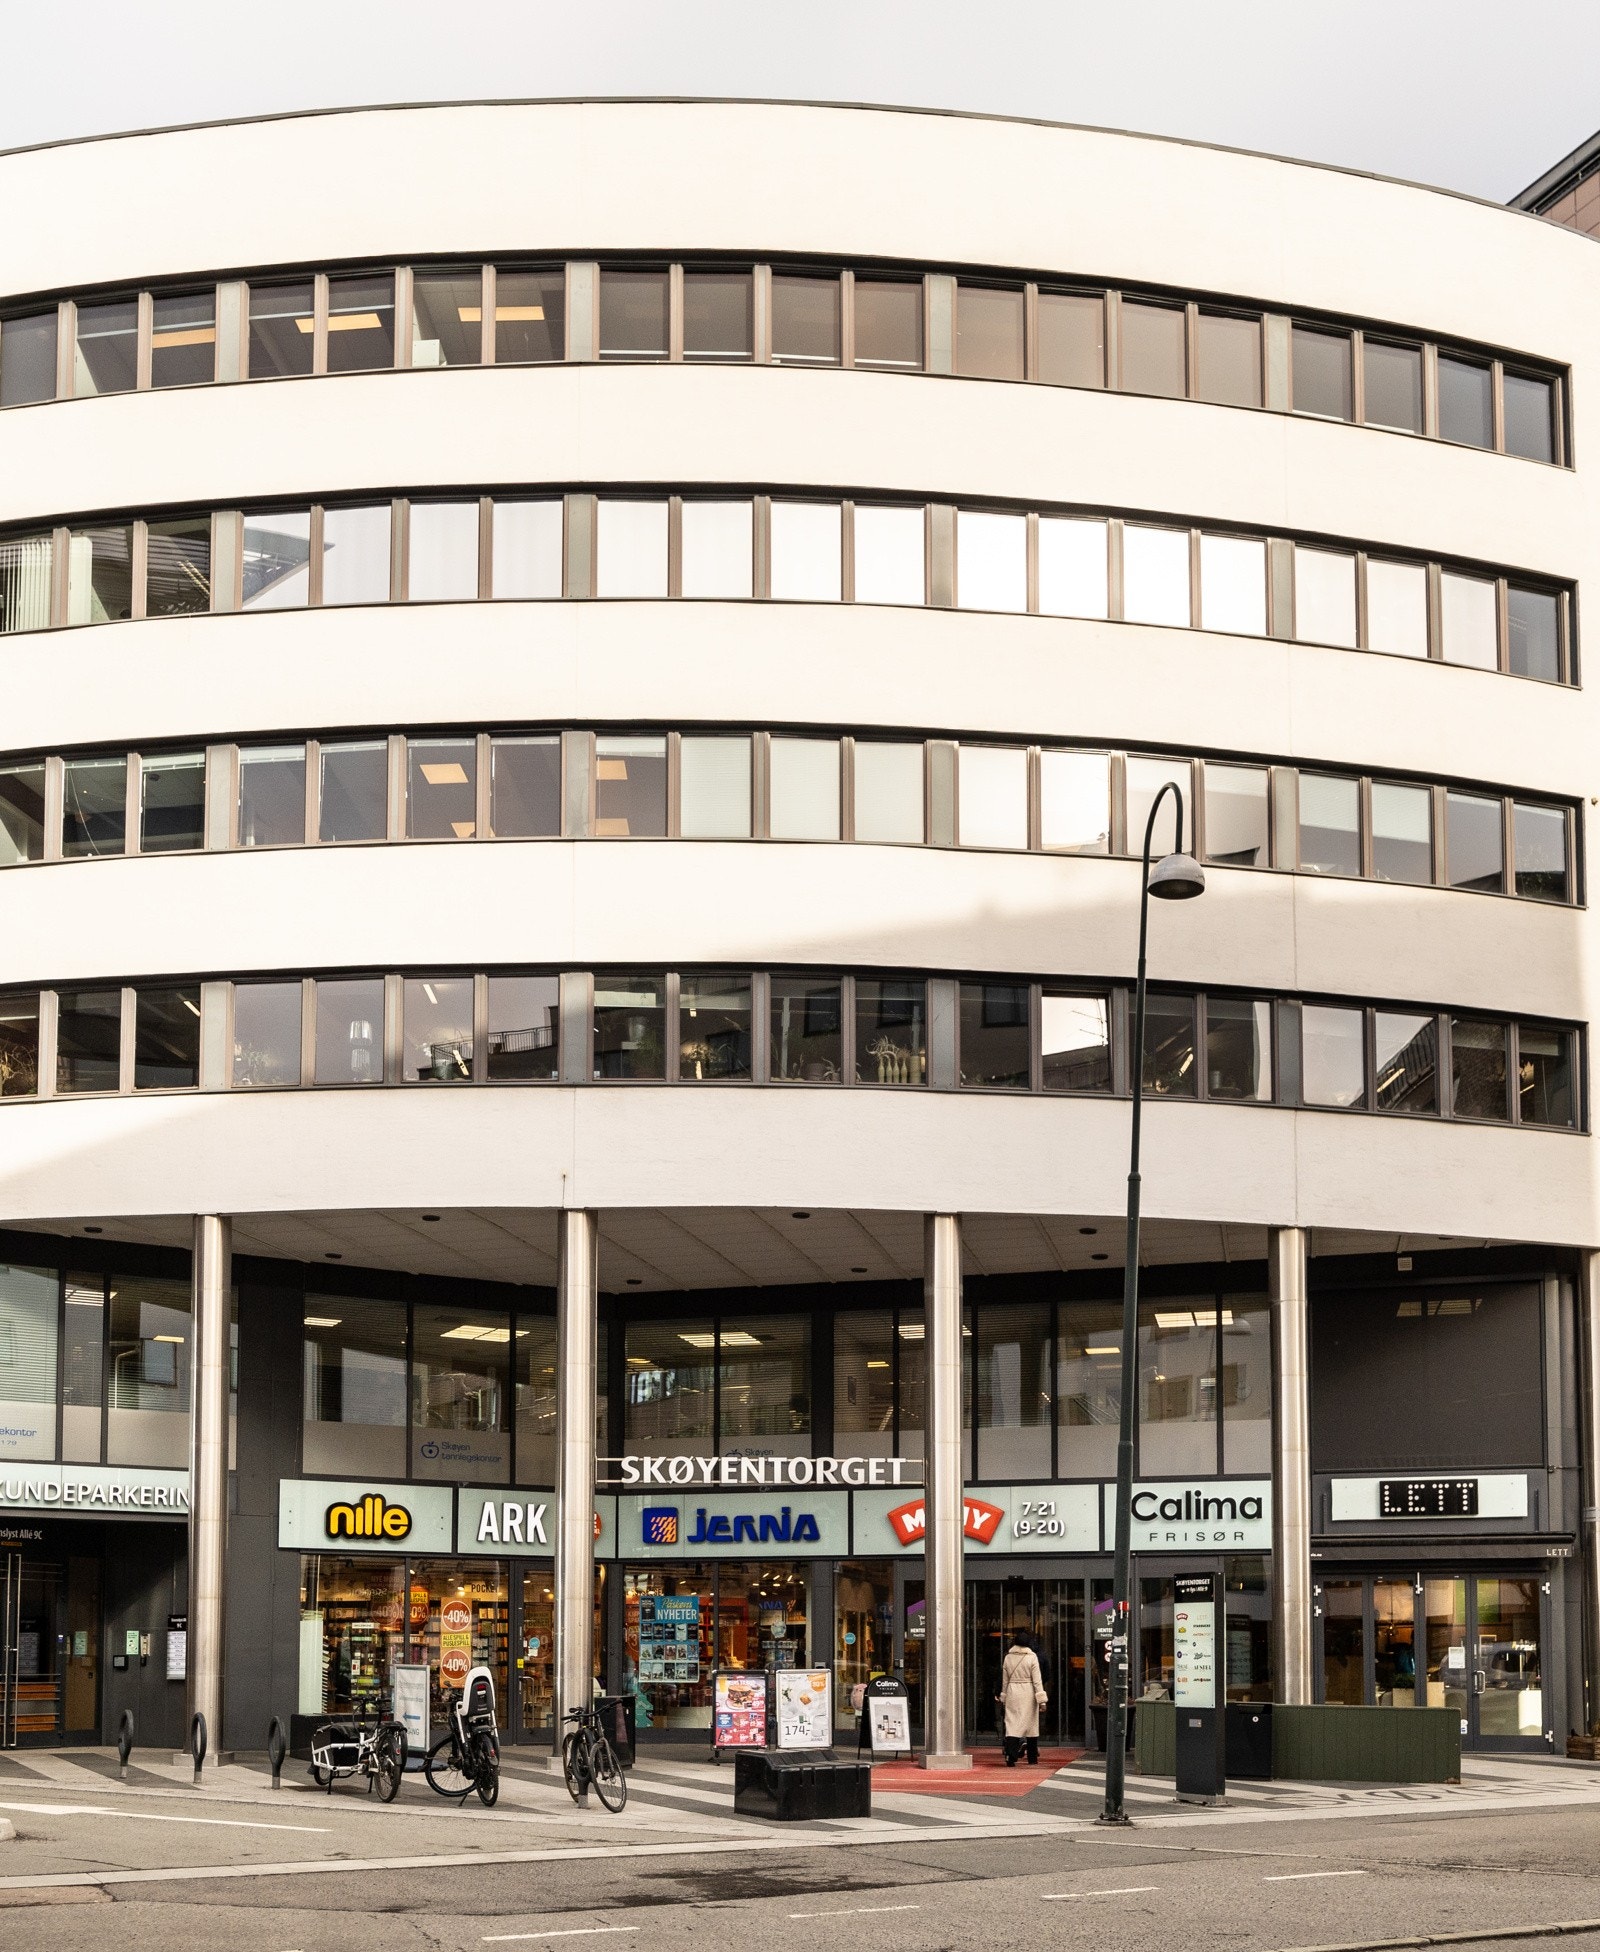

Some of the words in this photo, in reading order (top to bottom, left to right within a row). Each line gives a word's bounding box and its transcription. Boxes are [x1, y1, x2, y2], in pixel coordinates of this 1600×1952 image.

[441, 1442, 471, 1452] Skøyen
[745, 1448, 774, 1457] Skøyen
[441, 1452, 502, 1463] tannlegekontor
[620, 1455, 907, 1486] SKØYENTORGET
[1383, 1482, 1474, 1512] LETT
[1022, 1501, 1057, 1517] 7-21
[1130, 1490, 1264, 1522] Calima
[329, 1497, 410, 1538] nille
[477, 1501, 547, 1543] ARK
[19, 1529, 33, 1540] Allé
[33, 1530, 43, 1540] 9C
[1013, 1520, 1067, 1538] (9-20)
[1149, 1531, 1245, 1542] FRISØR
[1546, 1548, 1568, 1556] LETT
[662, 1597, 693, 1609] Påskens
[443, 1610, 470, 1623] -40%
[657, 1609, 697, 1620] NYHETER
[443, 1659, 468, 1672] -40%
[785, 1726, 811, 1736] 174,-
